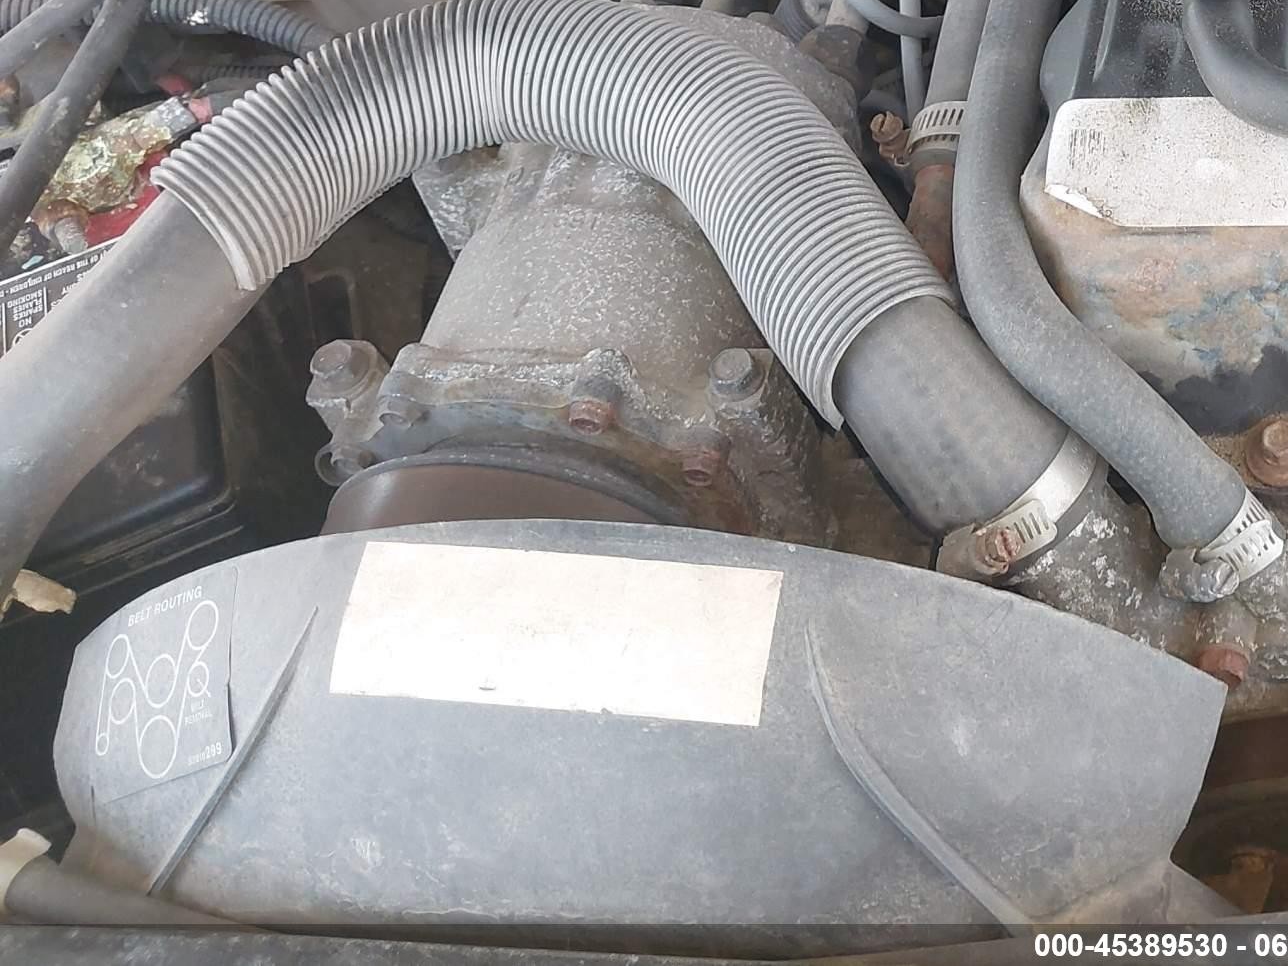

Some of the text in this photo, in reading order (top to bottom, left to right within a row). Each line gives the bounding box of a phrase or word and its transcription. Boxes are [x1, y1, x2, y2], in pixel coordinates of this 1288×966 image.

[7, 289, 43, 309] SMOKING
[18, 316, 32, 328] NO
[127, 585, 203, 628] BELT ROUTING
